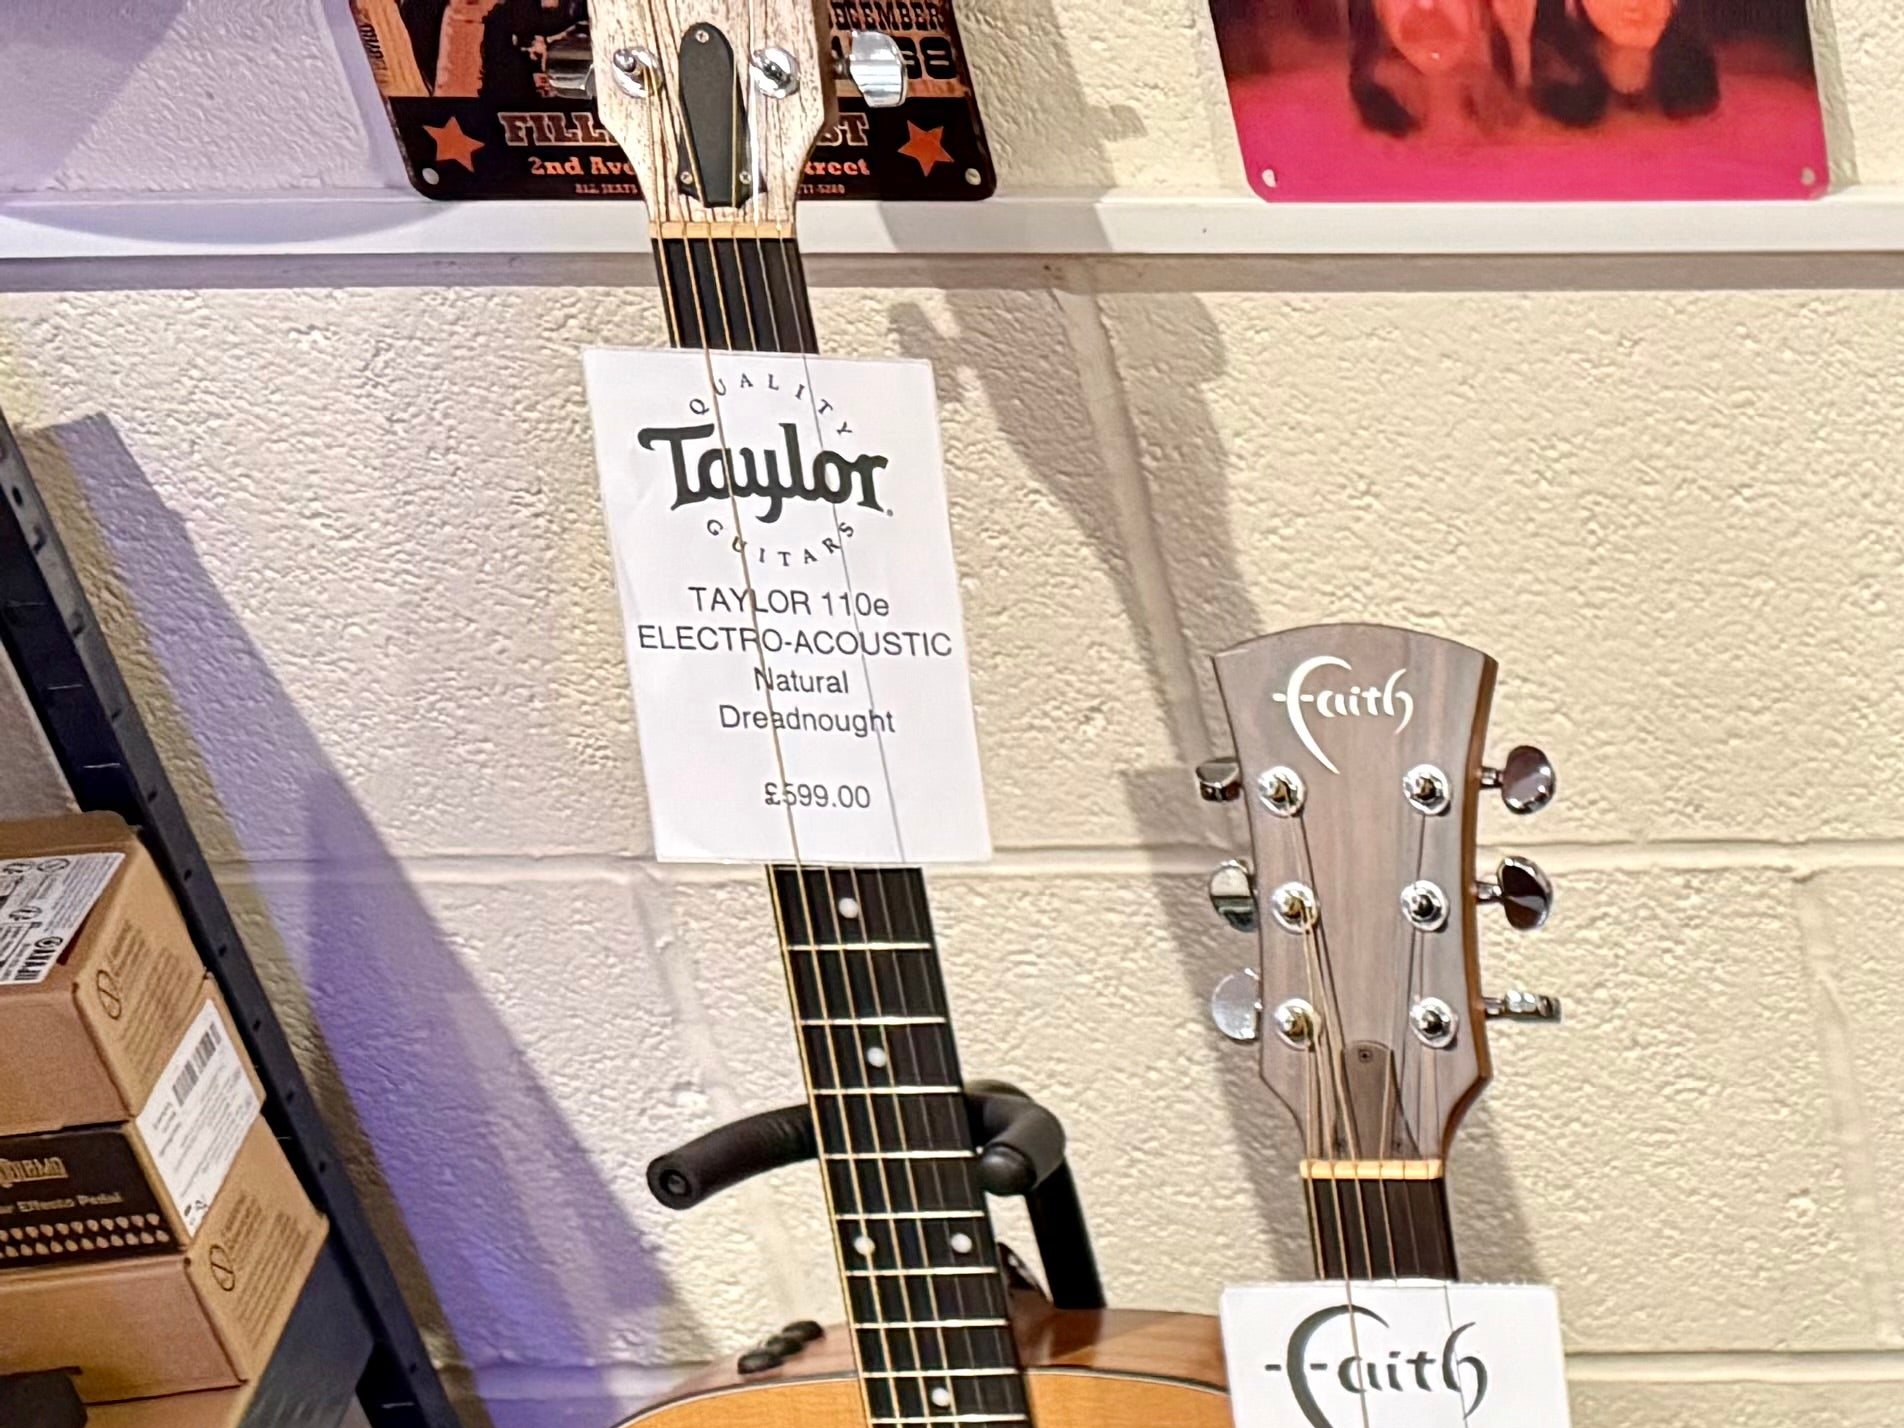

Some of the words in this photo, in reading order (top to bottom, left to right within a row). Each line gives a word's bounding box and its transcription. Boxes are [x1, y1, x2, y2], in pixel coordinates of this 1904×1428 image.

[528, 156, 585, 176] 2nd
[638, 422, 889, 523] Taylor
[688, 586, 812, 615] TAYLOR
[822, 592, 890, 617] 110e
[638, 624, 953, 657] ELECTRO-ACOUSTIC
[754, 667, 849, 694] Natural
[719, 704, 896, 738] Dreadnought
[1272, 655, 1414, 775] Faith
[765, 782, 871, 809] £599.00
